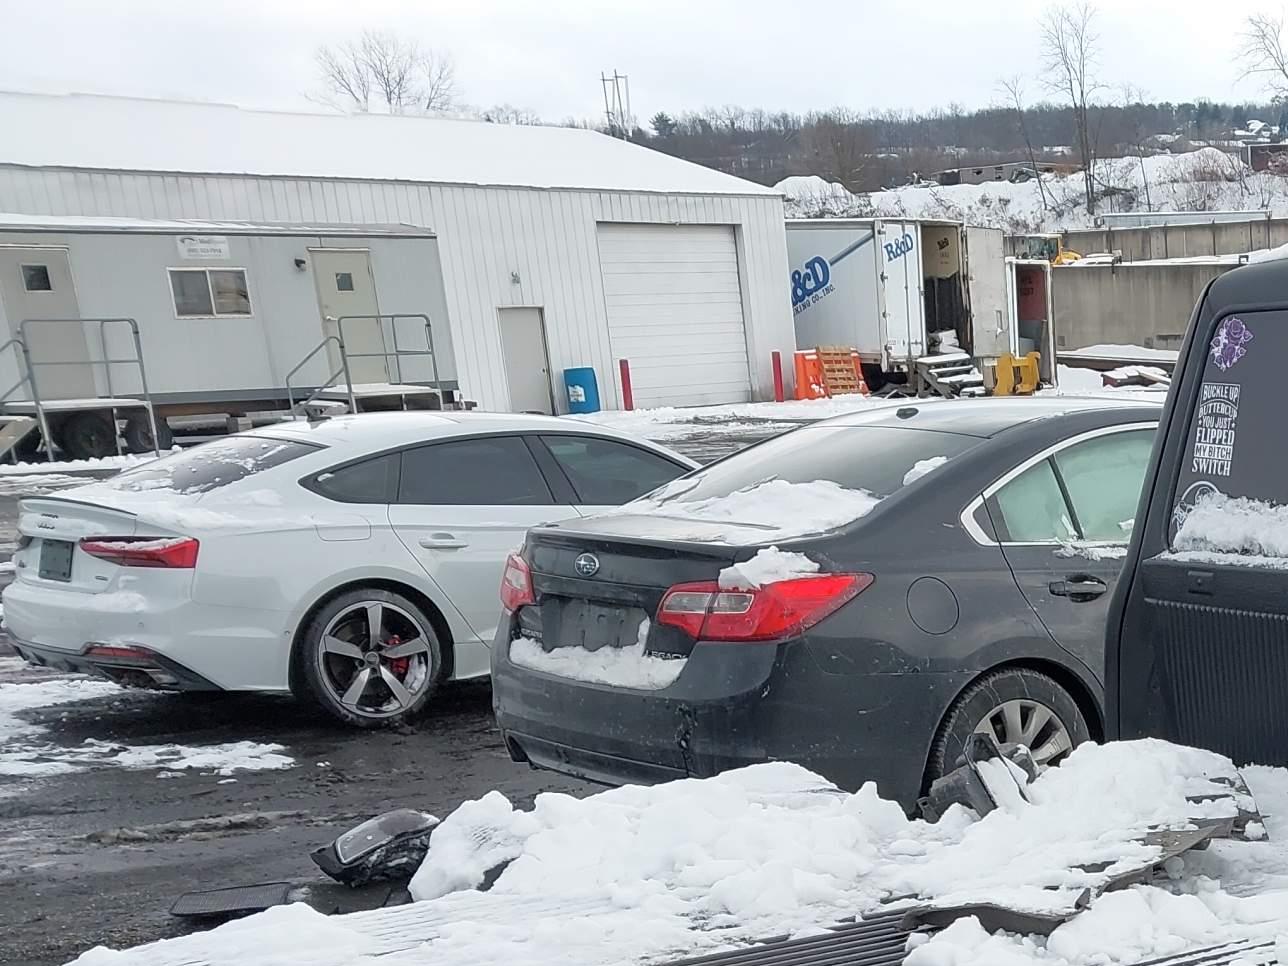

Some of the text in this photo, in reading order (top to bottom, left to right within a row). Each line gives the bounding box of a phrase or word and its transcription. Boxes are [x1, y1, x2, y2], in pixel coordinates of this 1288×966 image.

[884, 233, 914, 263] R&D
[791, 255, 830, 307] &D
[1203, 385, 1239, 402] BUCKLE UP
[1199, 402, 1238, 420] BUTTERCUP
[1202, 416, 1232, 430] YOU JUST
[1196, 427, 1235, 446] FLIPPED
[1195, 443, 1232, 460] MY BITCH
[1192, 458, 1231, 476] SWITCH
